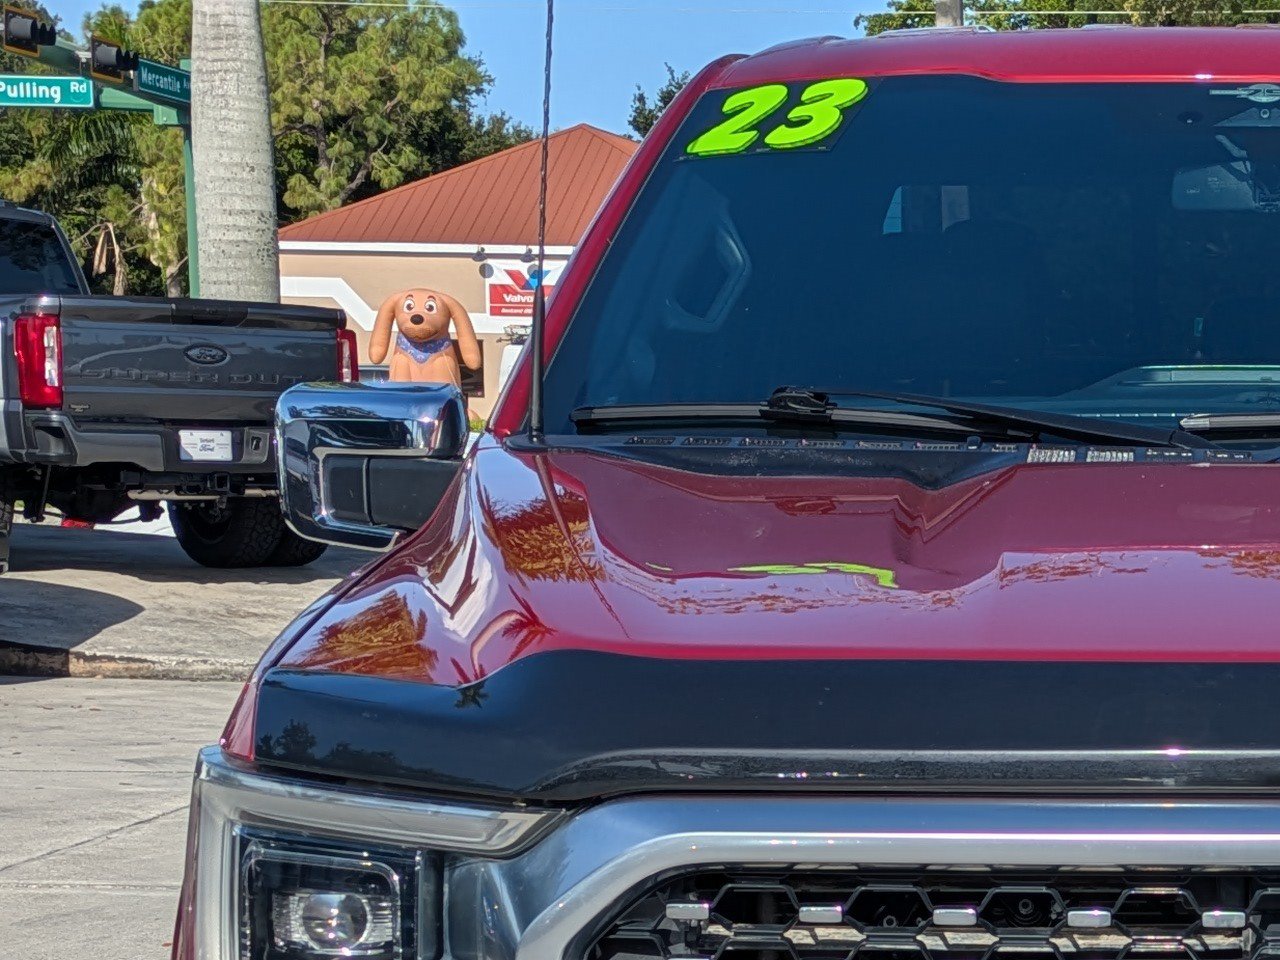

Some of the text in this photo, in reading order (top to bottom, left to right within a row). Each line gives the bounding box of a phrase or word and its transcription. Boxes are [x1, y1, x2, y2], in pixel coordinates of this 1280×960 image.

[70, 81, 87, 93] Rd
[141, 66, 180, 93] Mercantile
[687, 78, 868, 156] 23
[503, 293, 548, 303] Valvo
